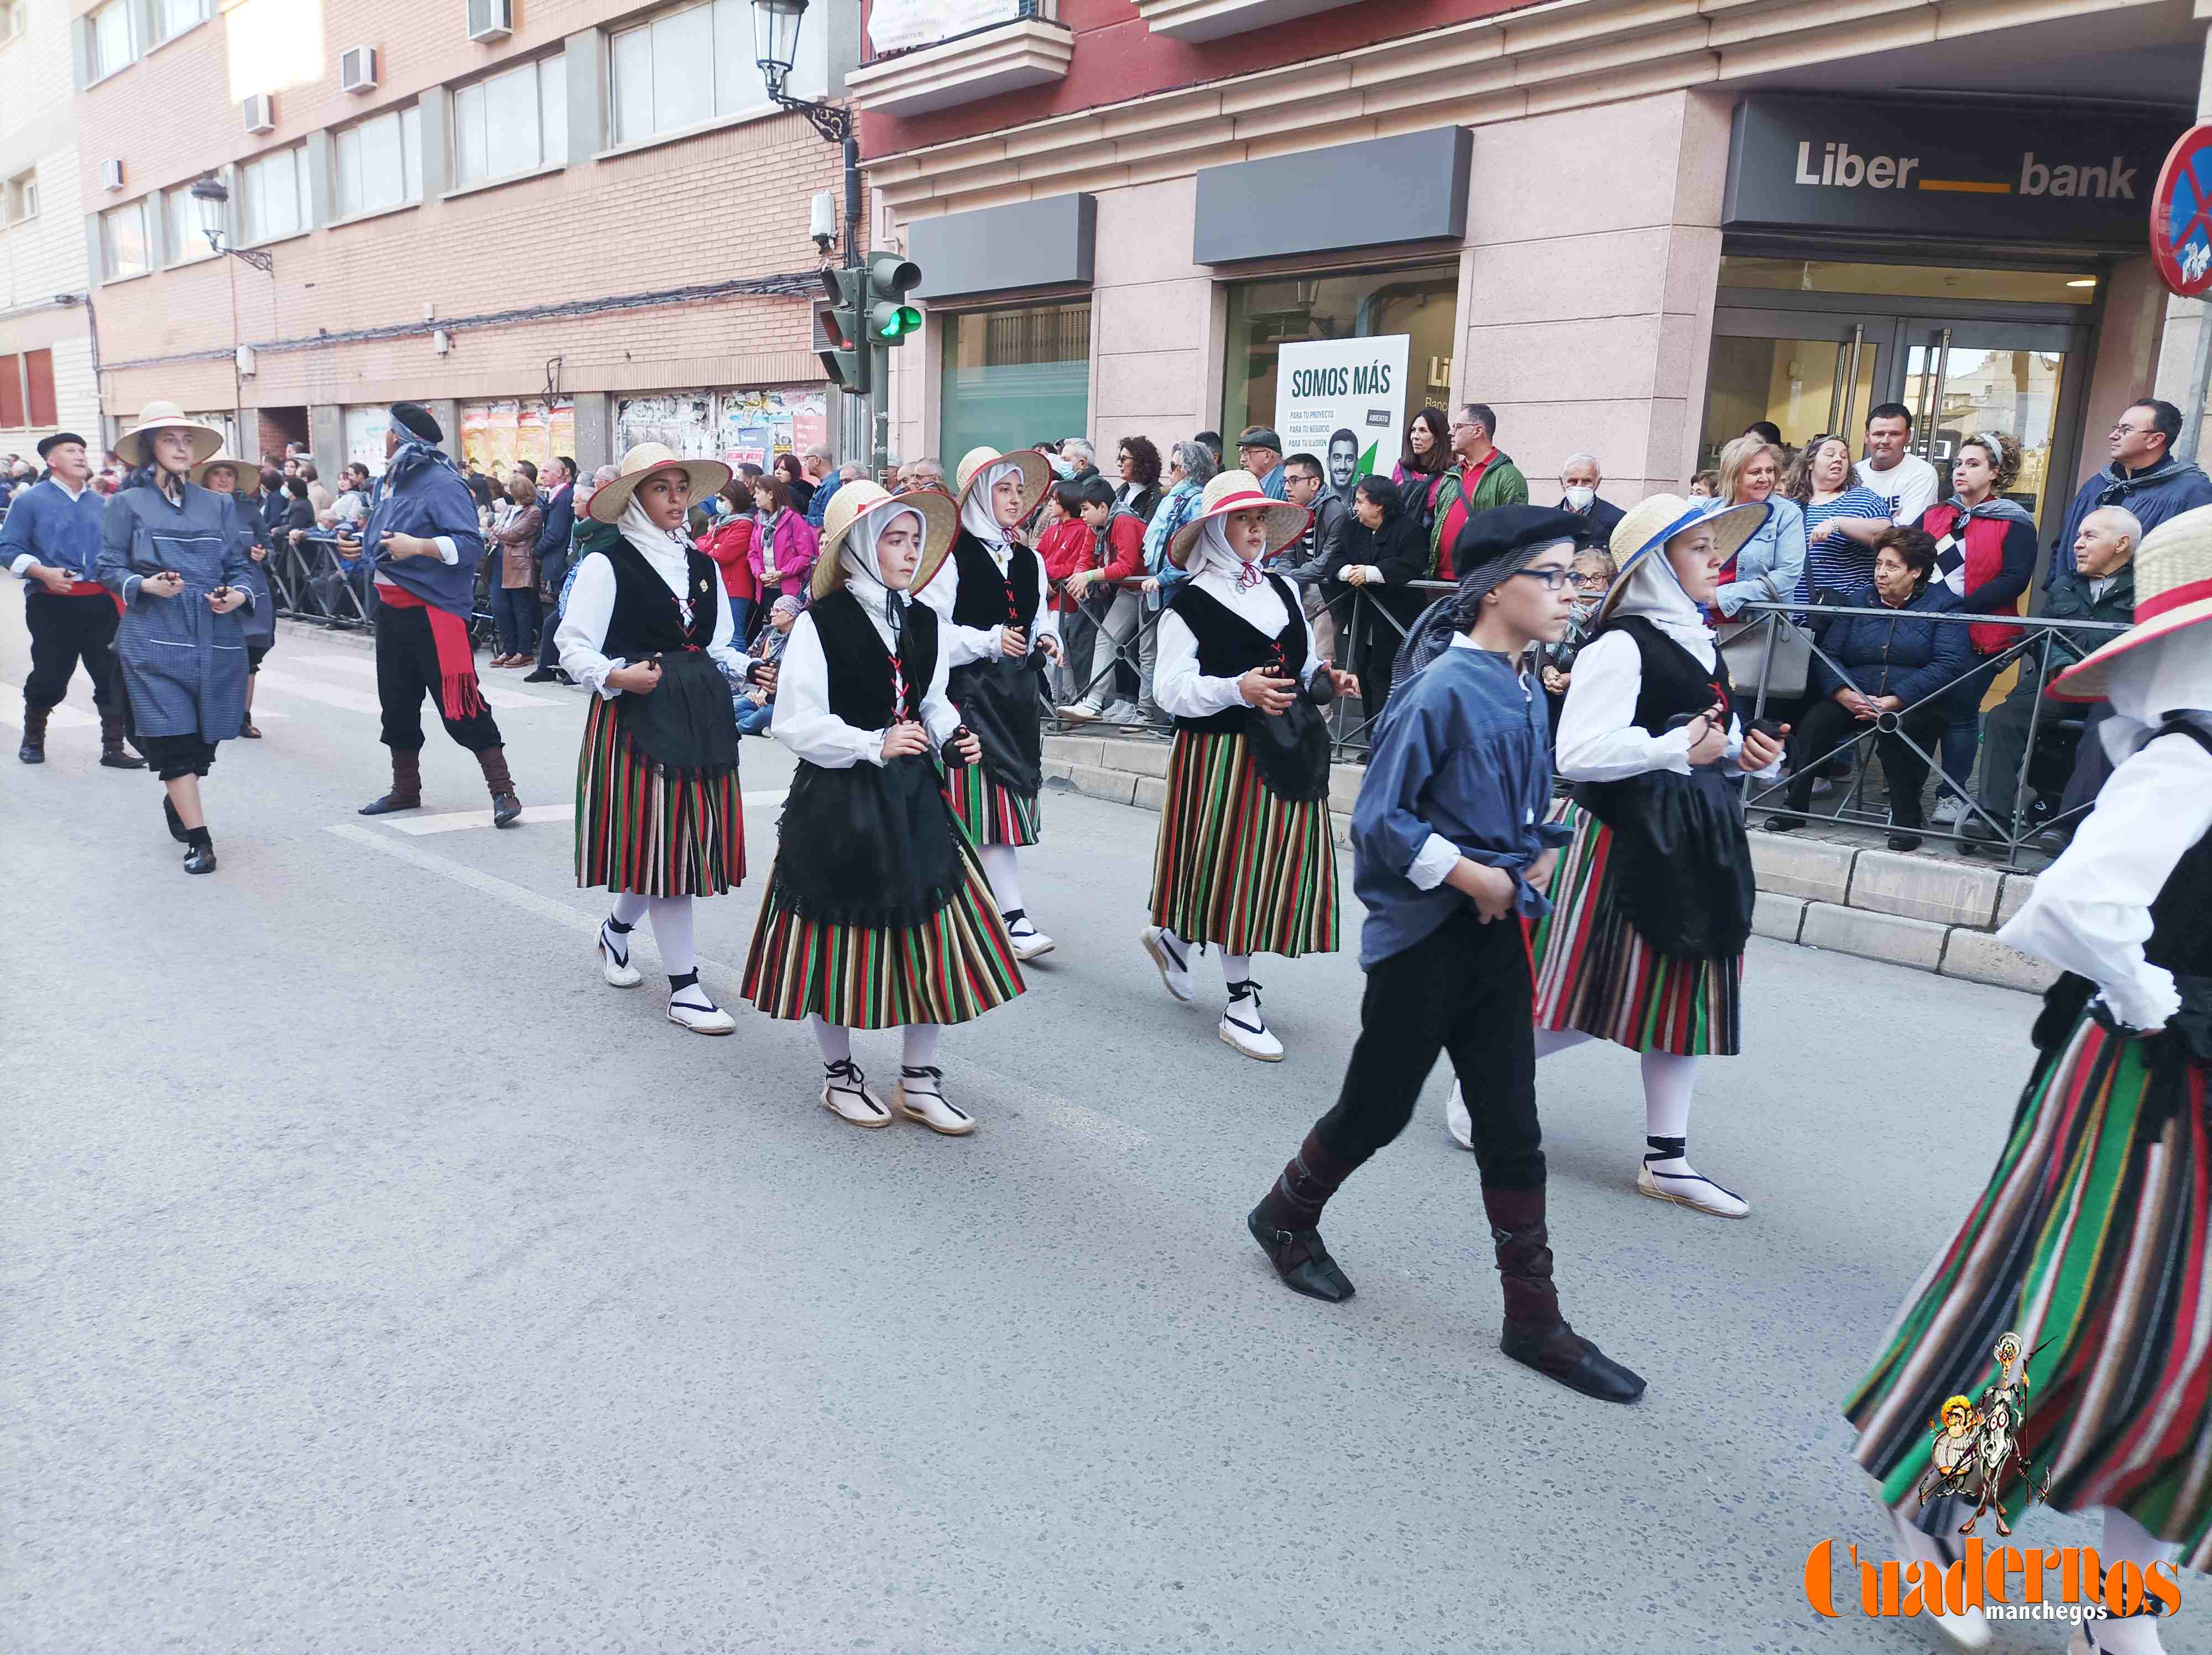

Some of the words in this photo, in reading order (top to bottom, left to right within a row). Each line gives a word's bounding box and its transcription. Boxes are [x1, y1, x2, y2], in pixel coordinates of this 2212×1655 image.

[1795, 142, 1919, 189] Liber
[2019, 152, 2137, 199] bank
[1292, 367, 1349, 398] SOMOS
[1353, 359, 1391, 395] MÁS
[1290, 411, 1303, 419] PARA
[1303, 411, 1310, 419] TU
[1310, 410, 1334, 419] PROYECTO
[1369, 414, 1389, 423] ABIERTO
[1289, 425, 1302, 434] PARA
[1309, 424, 1330, 433] NEGOCIO
[1308, 438, 1327, 447] ILUSIÓN
